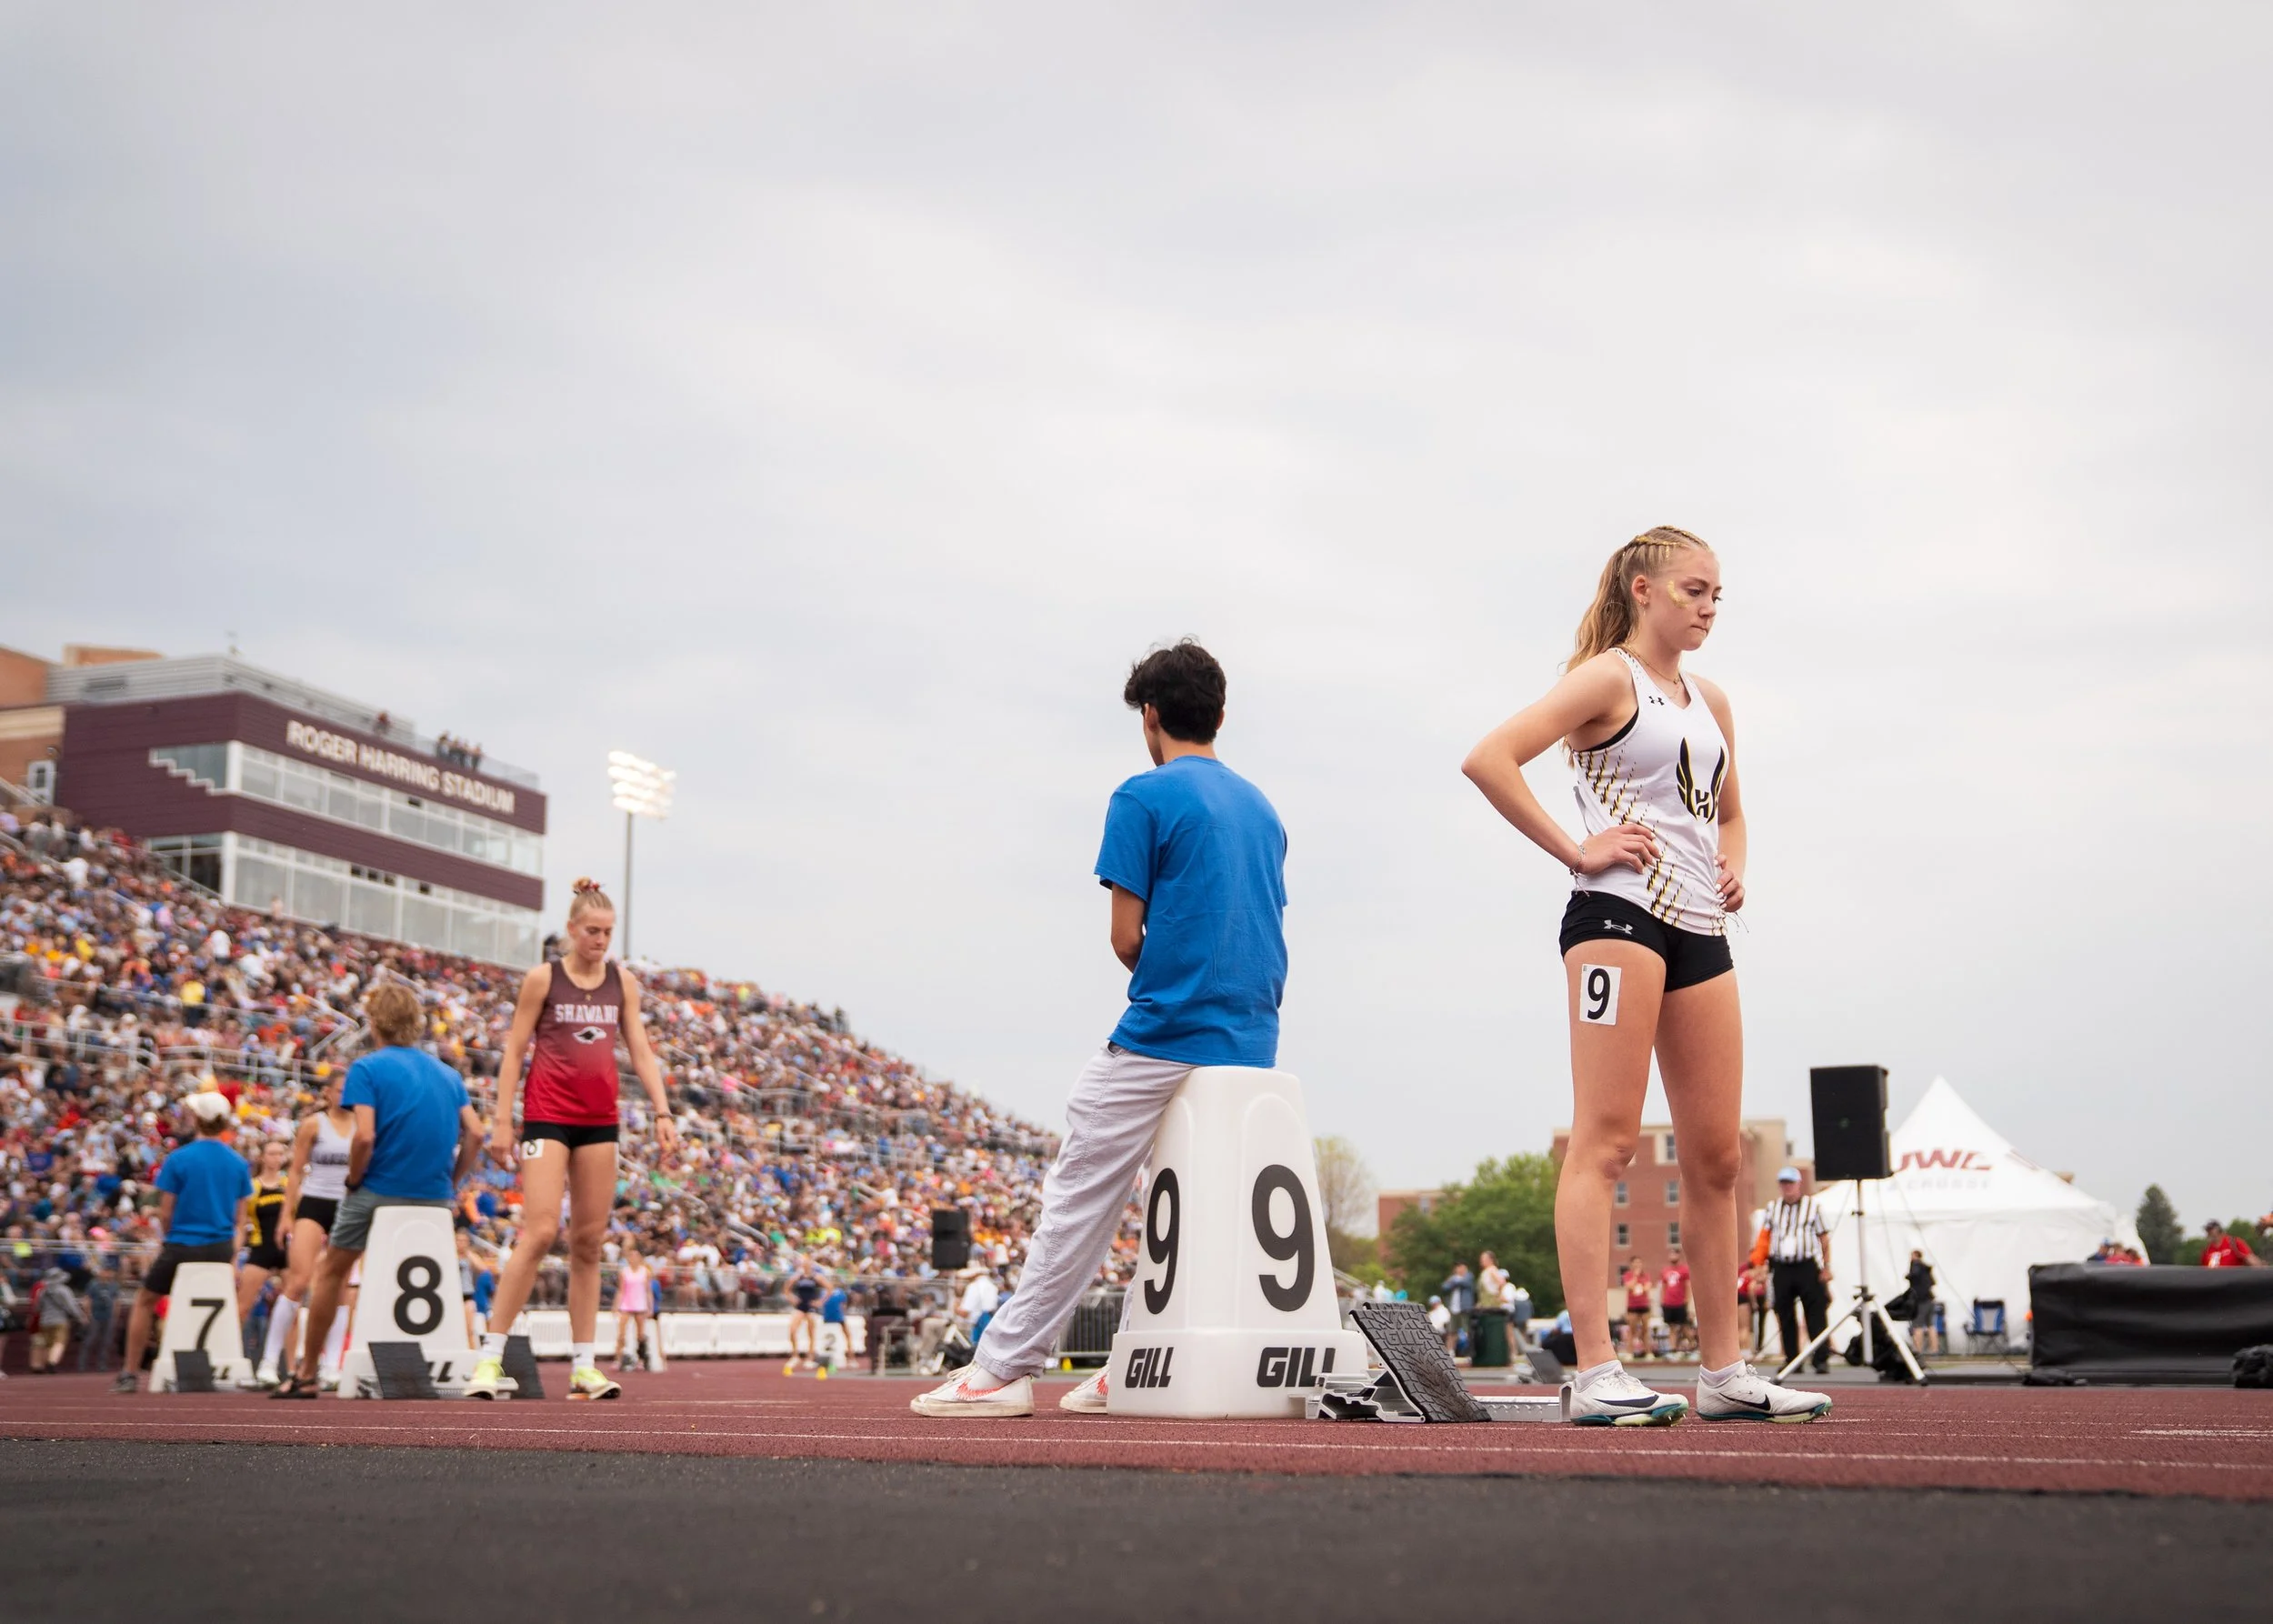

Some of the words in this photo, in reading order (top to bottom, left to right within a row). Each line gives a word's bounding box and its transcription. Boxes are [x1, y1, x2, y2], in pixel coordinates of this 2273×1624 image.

[286, 719, 357, 765] ROGER
[358, 742, 440, 792] HARRING
[442, 770, 516, 815] STADIUM
[1587, 967, 1611, 1020] 9
[1143, 1168, 1180, 1315] 9
[1251, 1163, 1316, 1313] 9
[190, 1298, 225, 1351] 7
[393, 1254, 445, 1336] 8
[1125, 1346, 1175, 1388] GILL
[1256, 1347, 1337, 1388] GILL
